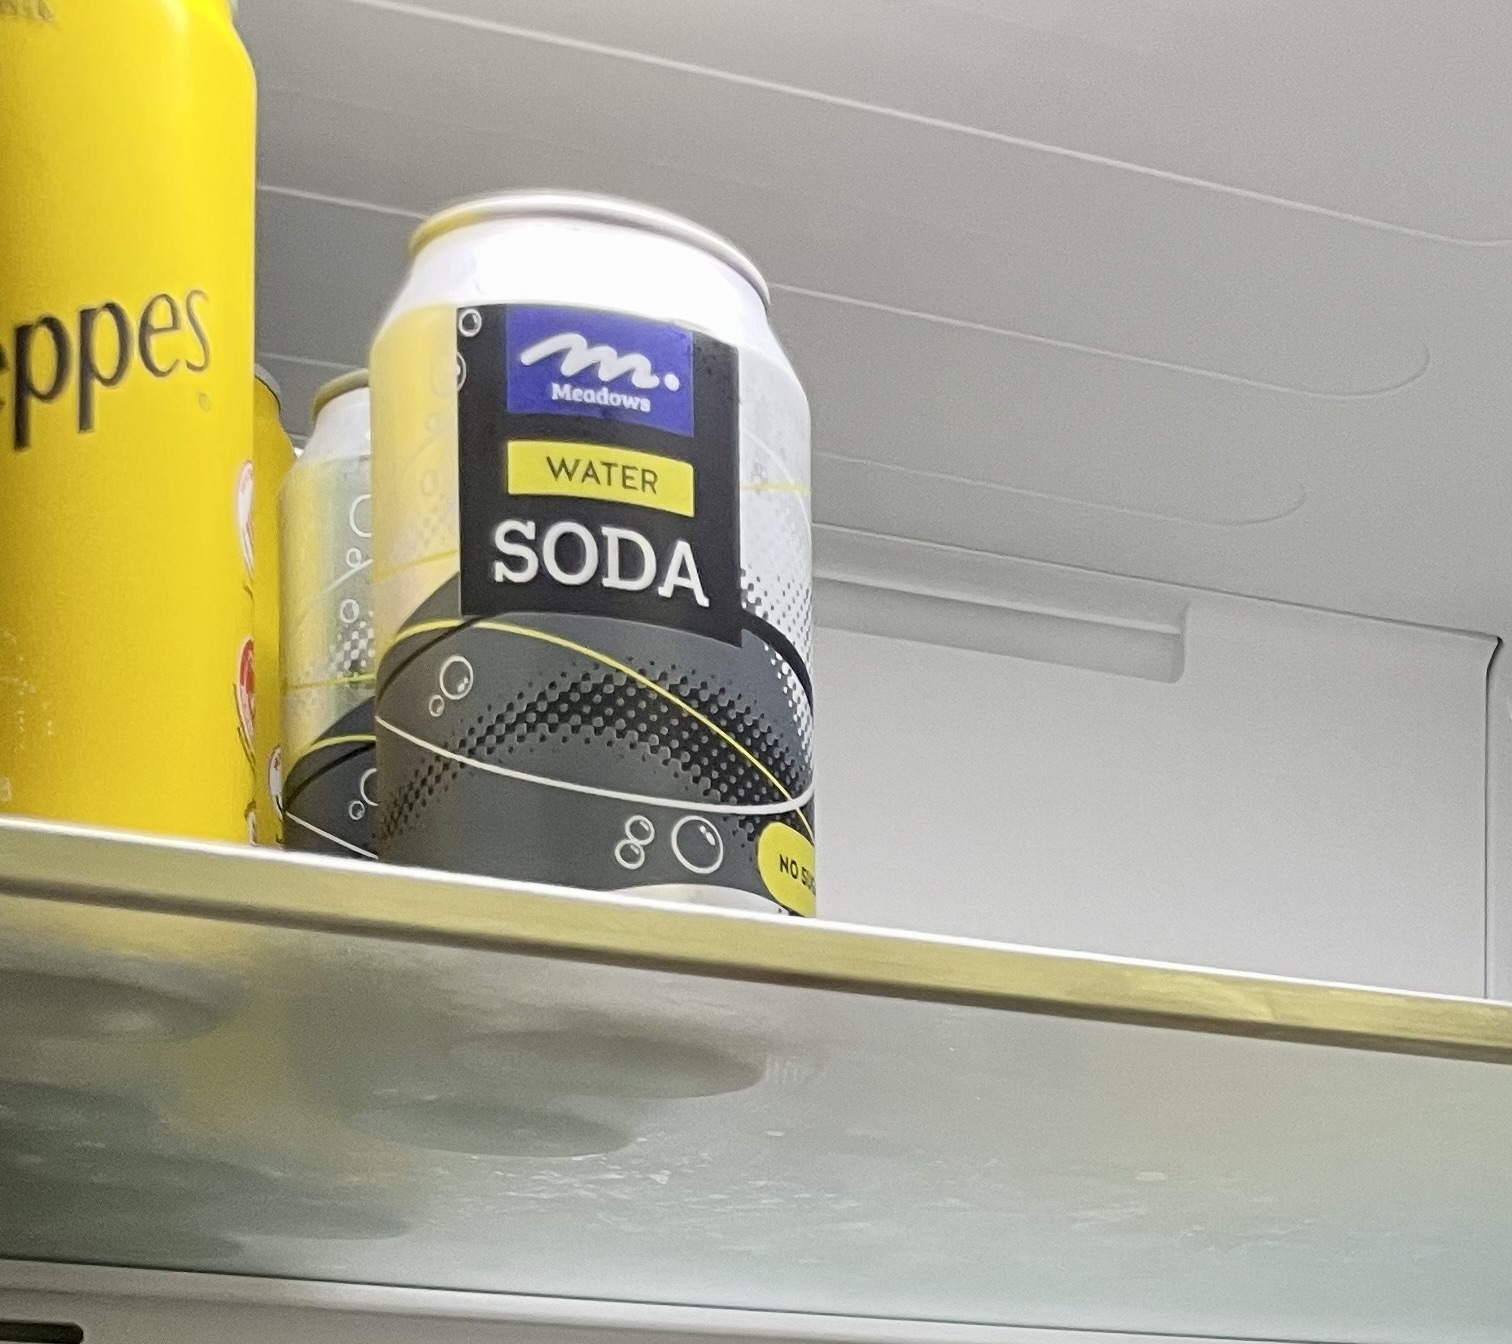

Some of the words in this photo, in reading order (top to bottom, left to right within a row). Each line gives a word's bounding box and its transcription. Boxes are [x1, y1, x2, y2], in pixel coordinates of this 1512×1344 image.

[0, 289, 210, 450] ppes
[551, 383, 651, 412] Meadows
[546, 456, 658, 494] WATER
[494, 519, 710, 607] SODA
[779, 853, 798, 879] NO
